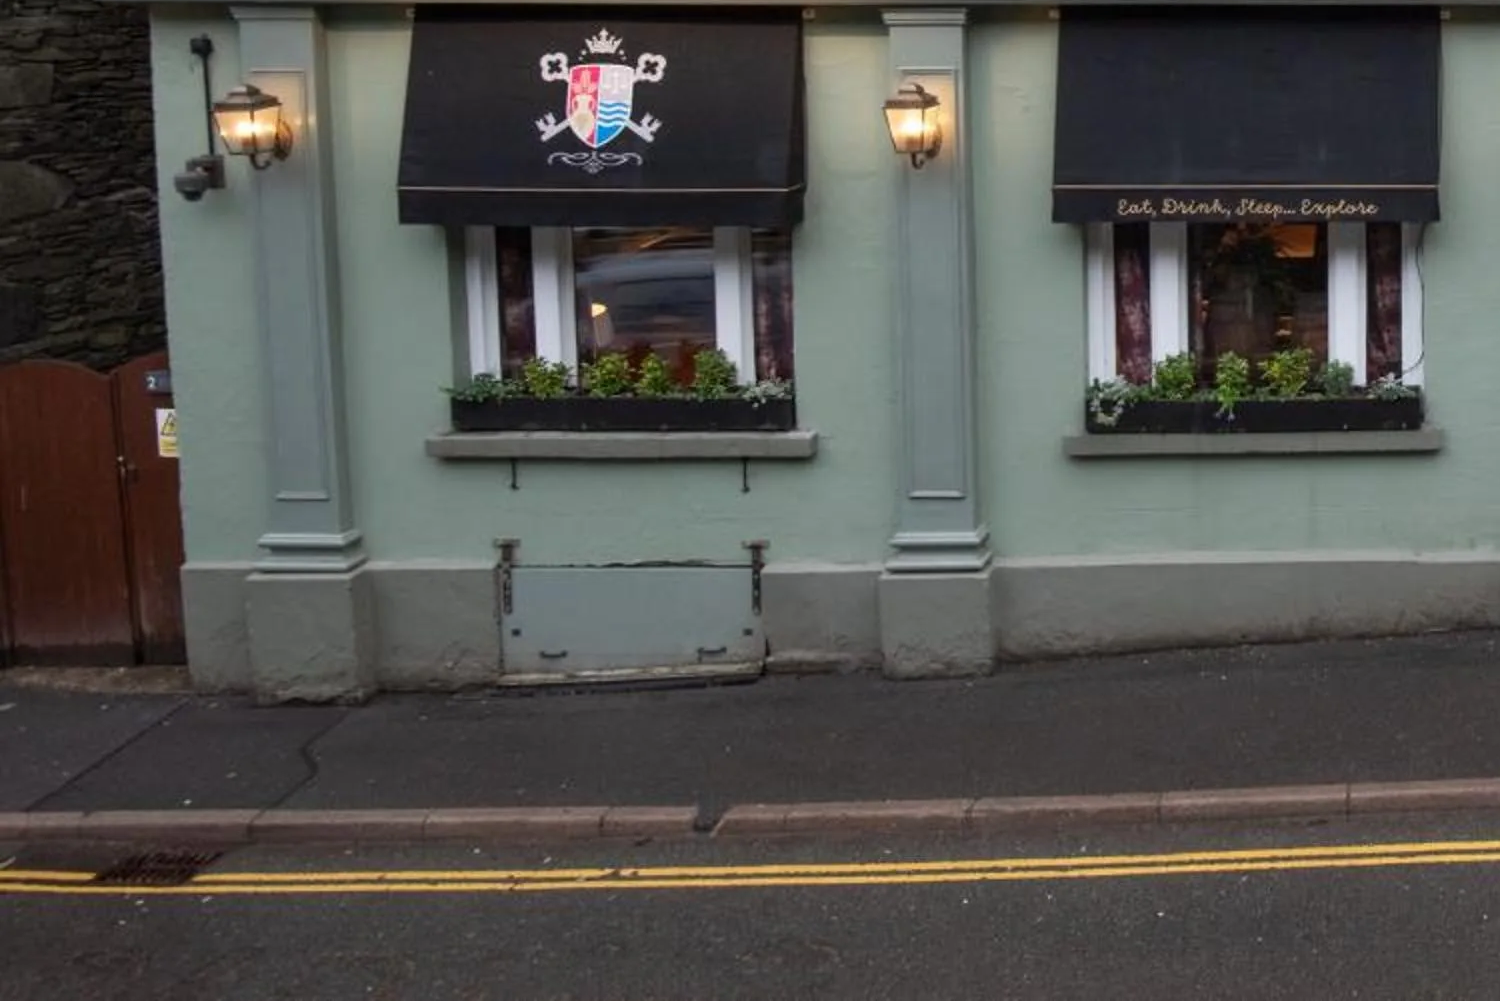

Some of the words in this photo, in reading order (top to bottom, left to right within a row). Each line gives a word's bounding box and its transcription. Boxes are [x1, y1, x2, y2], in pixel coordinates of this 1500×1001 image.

[1117, 198, 1157, 217] Eat,
[1161, 197, 1231, 218] Drink,
[1235, 198, 1296, 219] Sleep...
[1300, 198, 1379, 219] Explore
